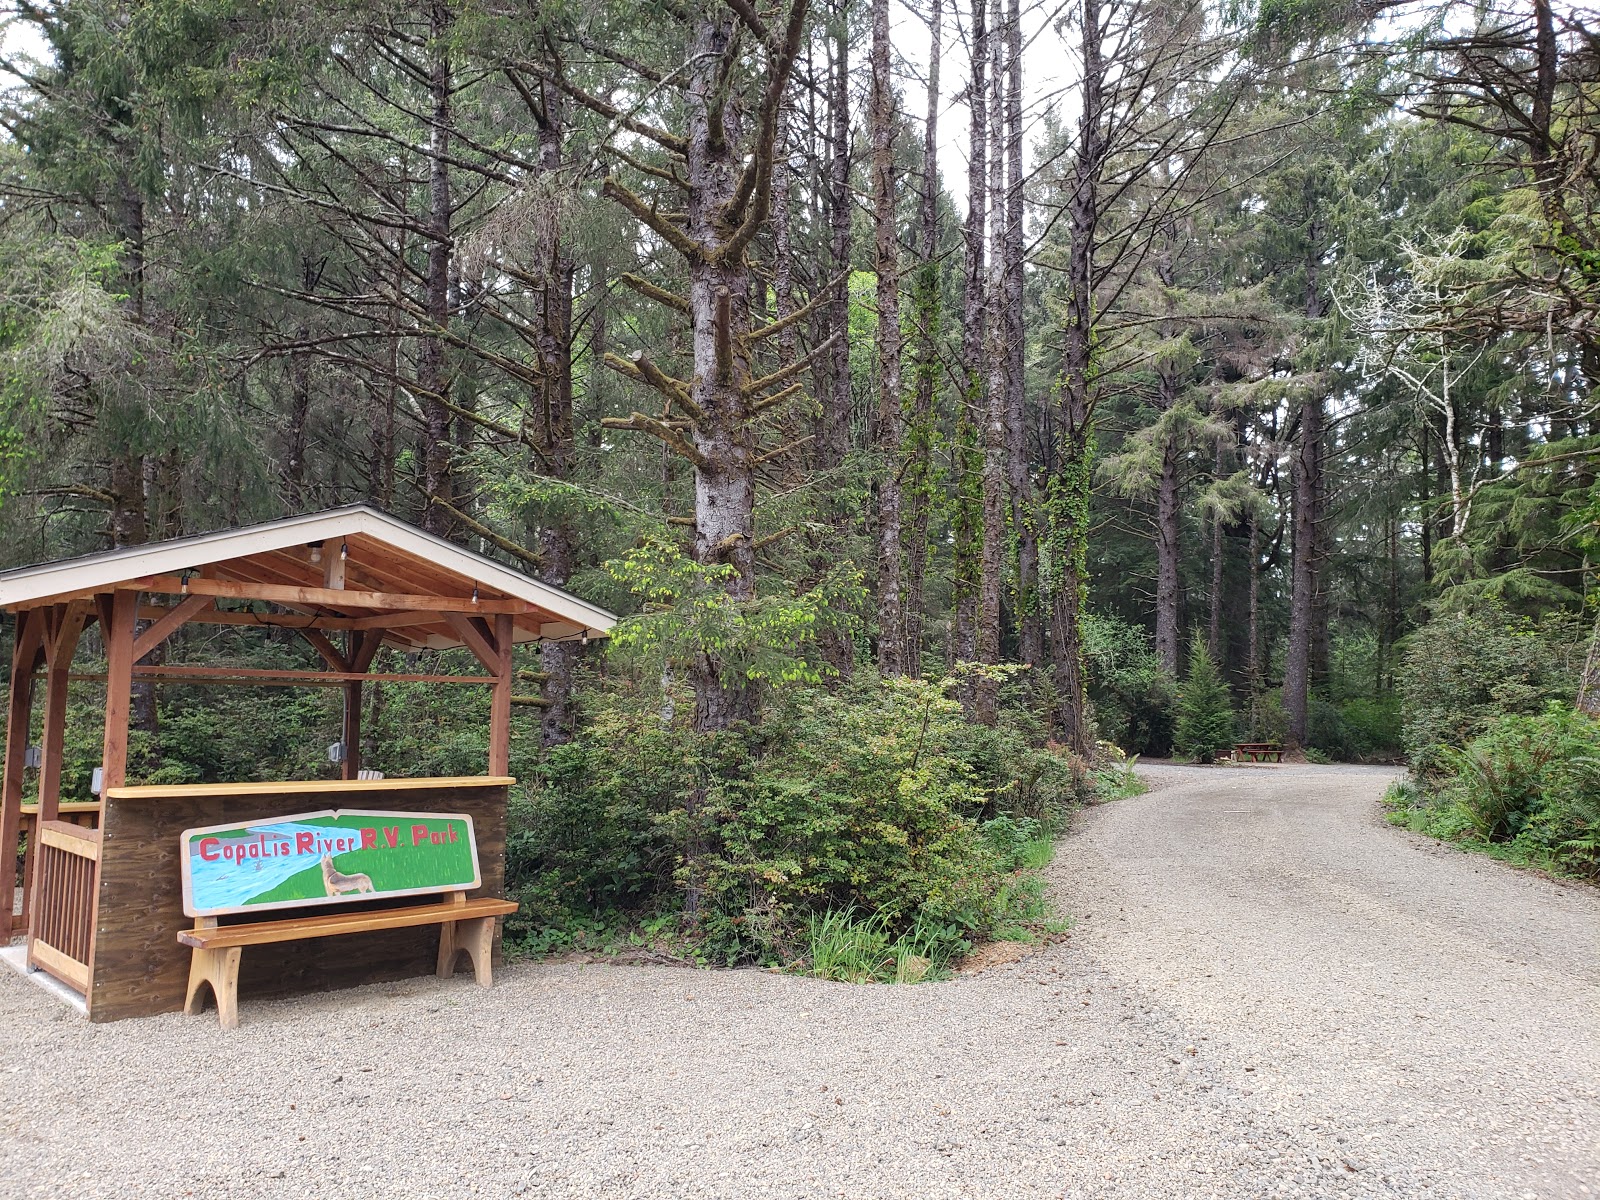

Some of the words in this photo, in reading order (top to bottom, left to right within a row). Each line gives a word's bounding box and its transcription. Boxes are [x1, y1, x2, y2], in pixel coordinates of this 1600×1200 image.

[295, 831, 355, 855] River
[360, 826, 405, 850] R.V.
[411, 823, 459, 847] Park
